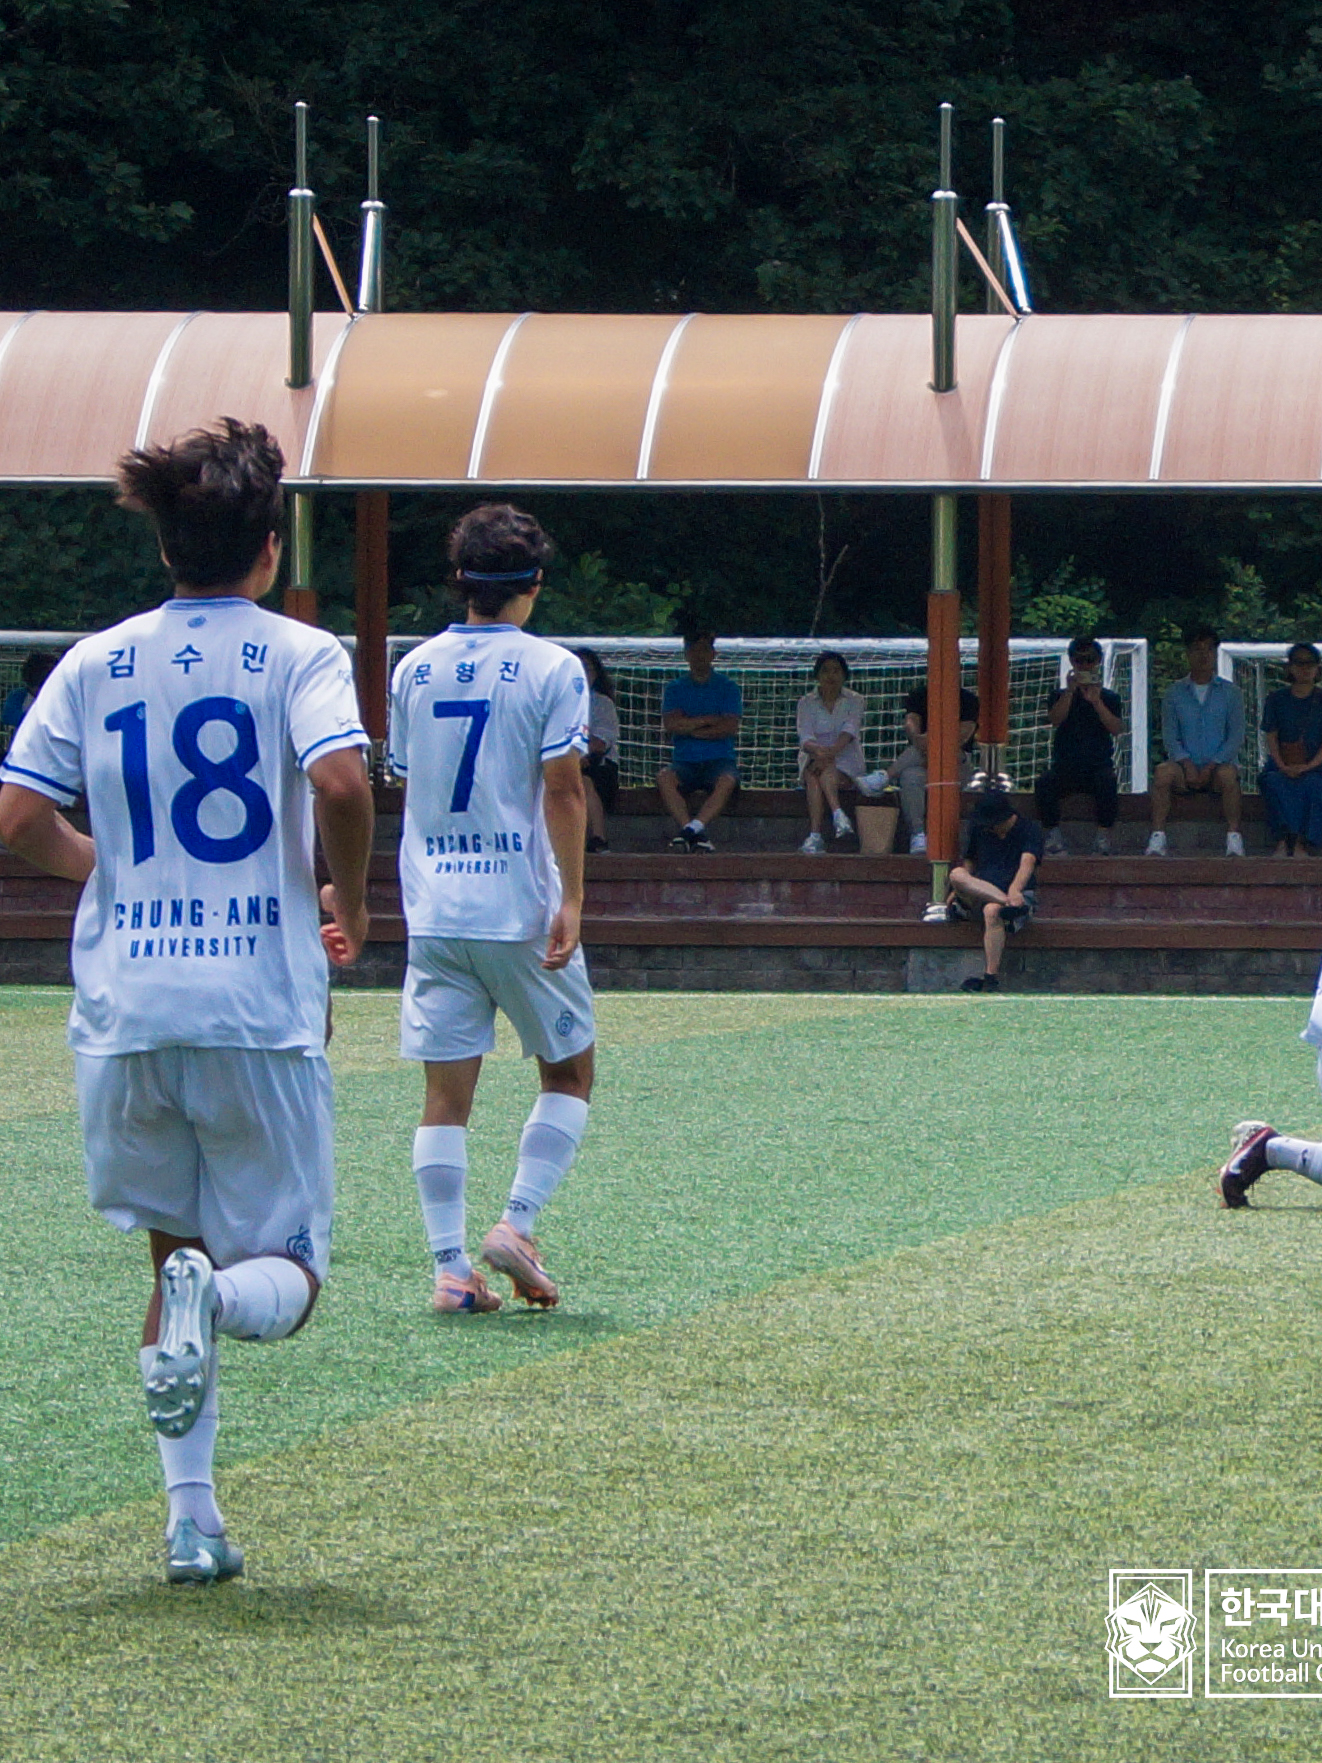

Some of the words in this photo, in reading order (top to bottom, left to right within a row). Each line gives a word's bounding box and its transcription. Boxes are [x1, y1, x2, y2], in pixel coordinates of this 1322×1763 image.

[104, 696, 274, 867] 18
[433, 699, 490, 813] 7
[130, 935, 256, 959] UNIVERSITY
